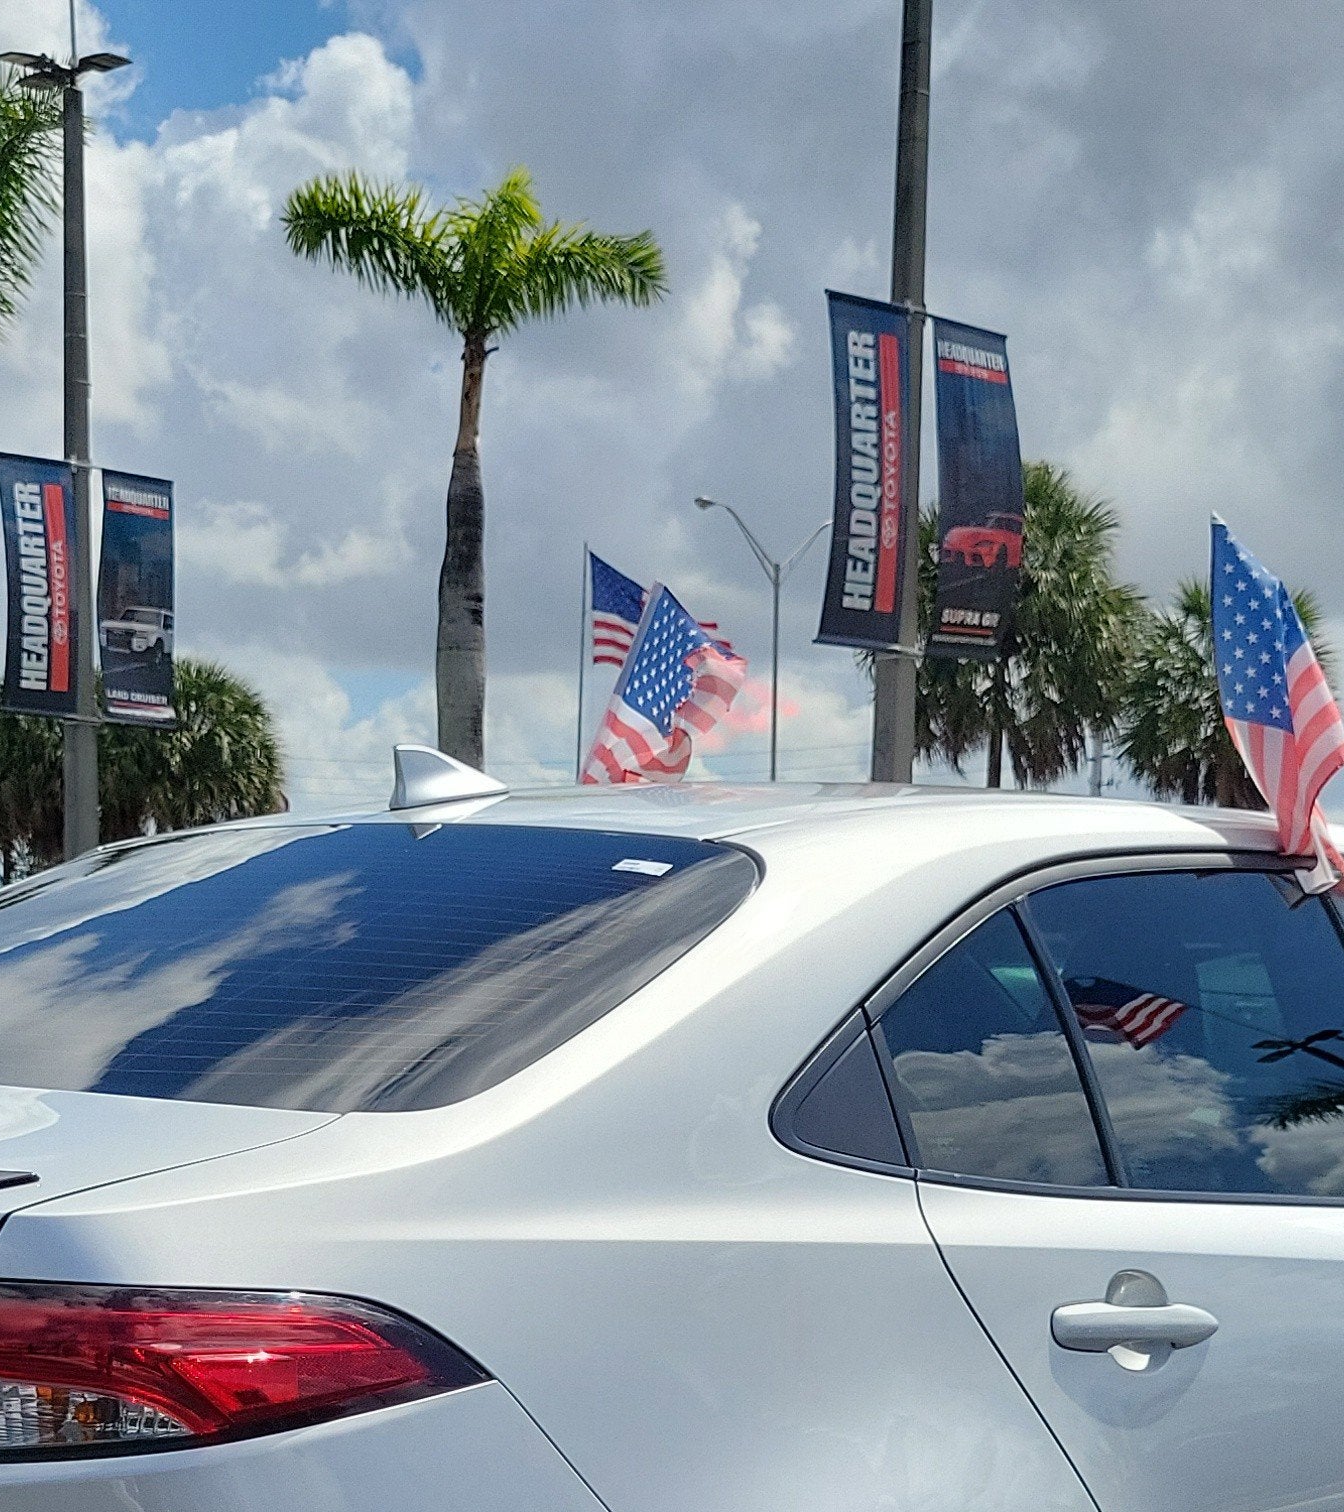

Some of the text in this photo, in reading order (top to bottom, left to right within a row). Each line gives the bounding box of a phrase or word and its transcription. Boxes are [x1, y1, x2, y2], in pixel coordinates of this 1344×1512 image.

[842, 330, 880, 611] HEADQUARTER
[881, 410, 898, 511] TOYOTA
[12, 481, 51, 690] HEADQUARTER
[52, 540, 67, 616] TOYOTA
